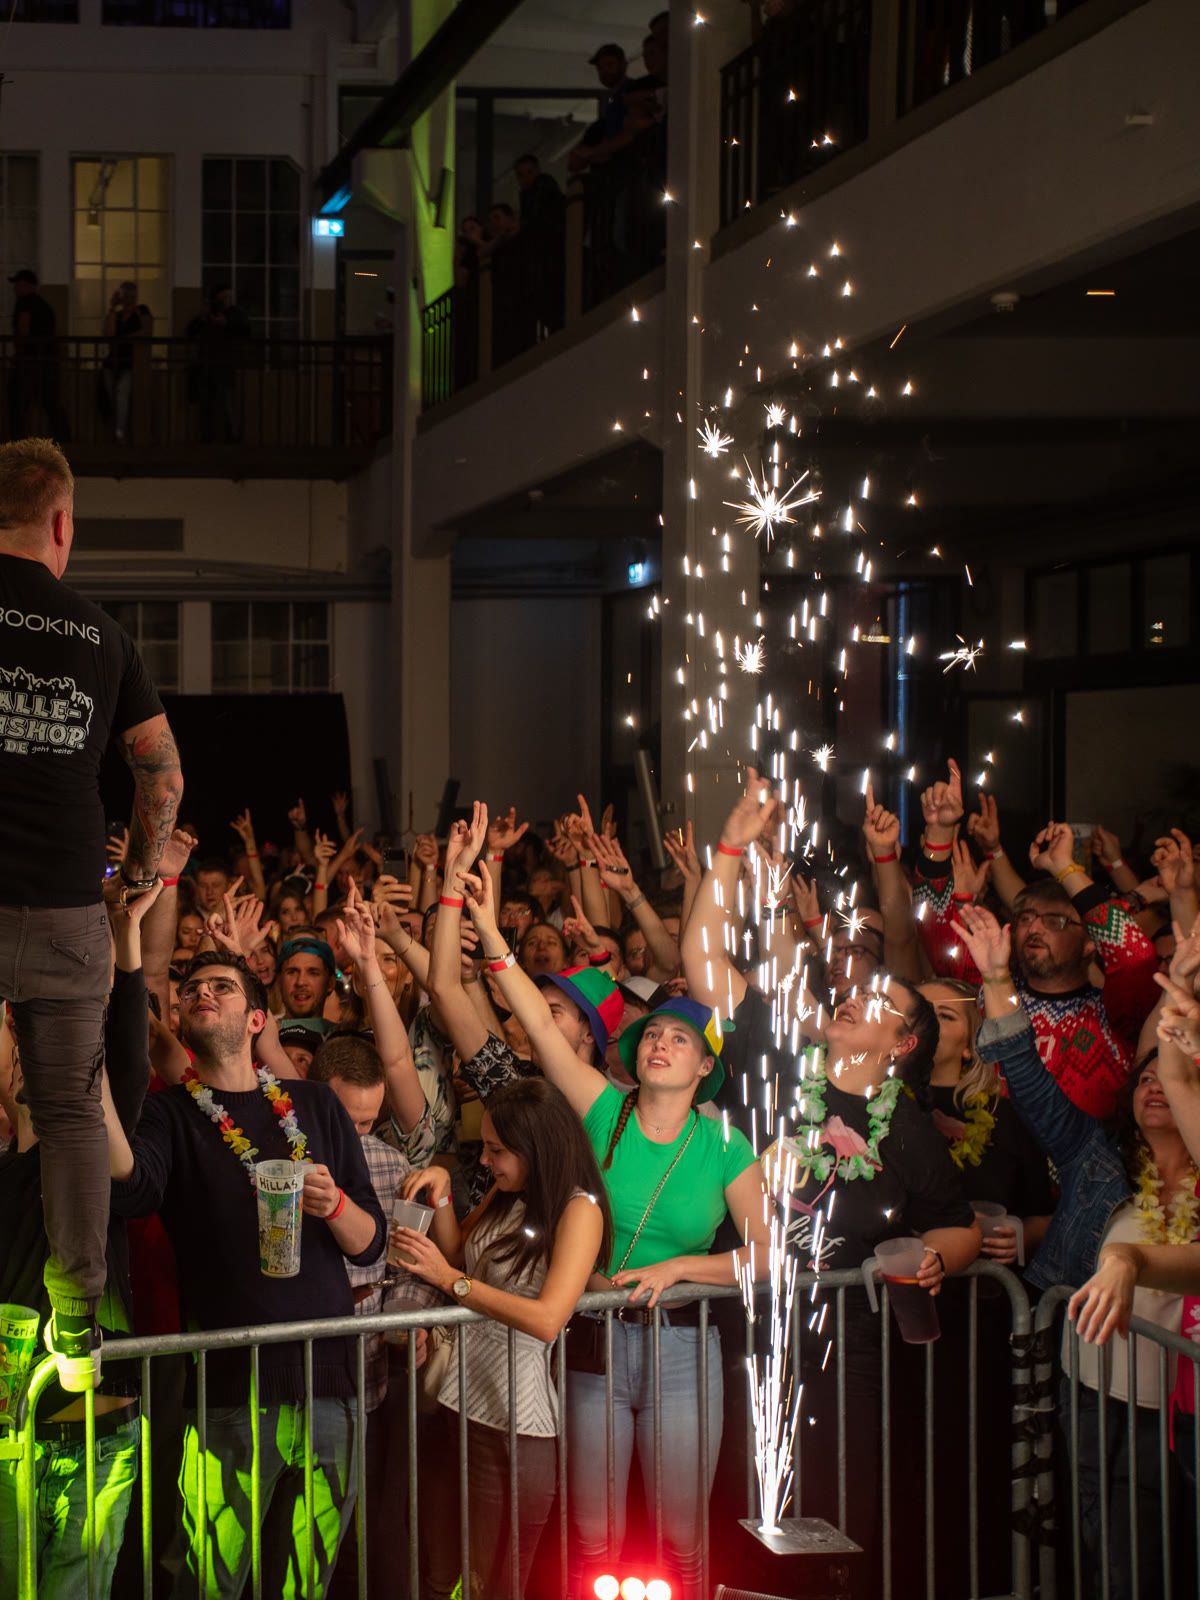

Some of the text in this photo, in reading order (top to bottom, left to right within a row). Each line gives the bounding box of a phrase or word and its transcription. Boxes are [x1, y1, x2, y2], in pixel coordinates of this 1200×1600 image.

[4, 739, 29, 755] DE
[31, 746, 49, 754] geht
[52, 747, 74, 755] weiter
